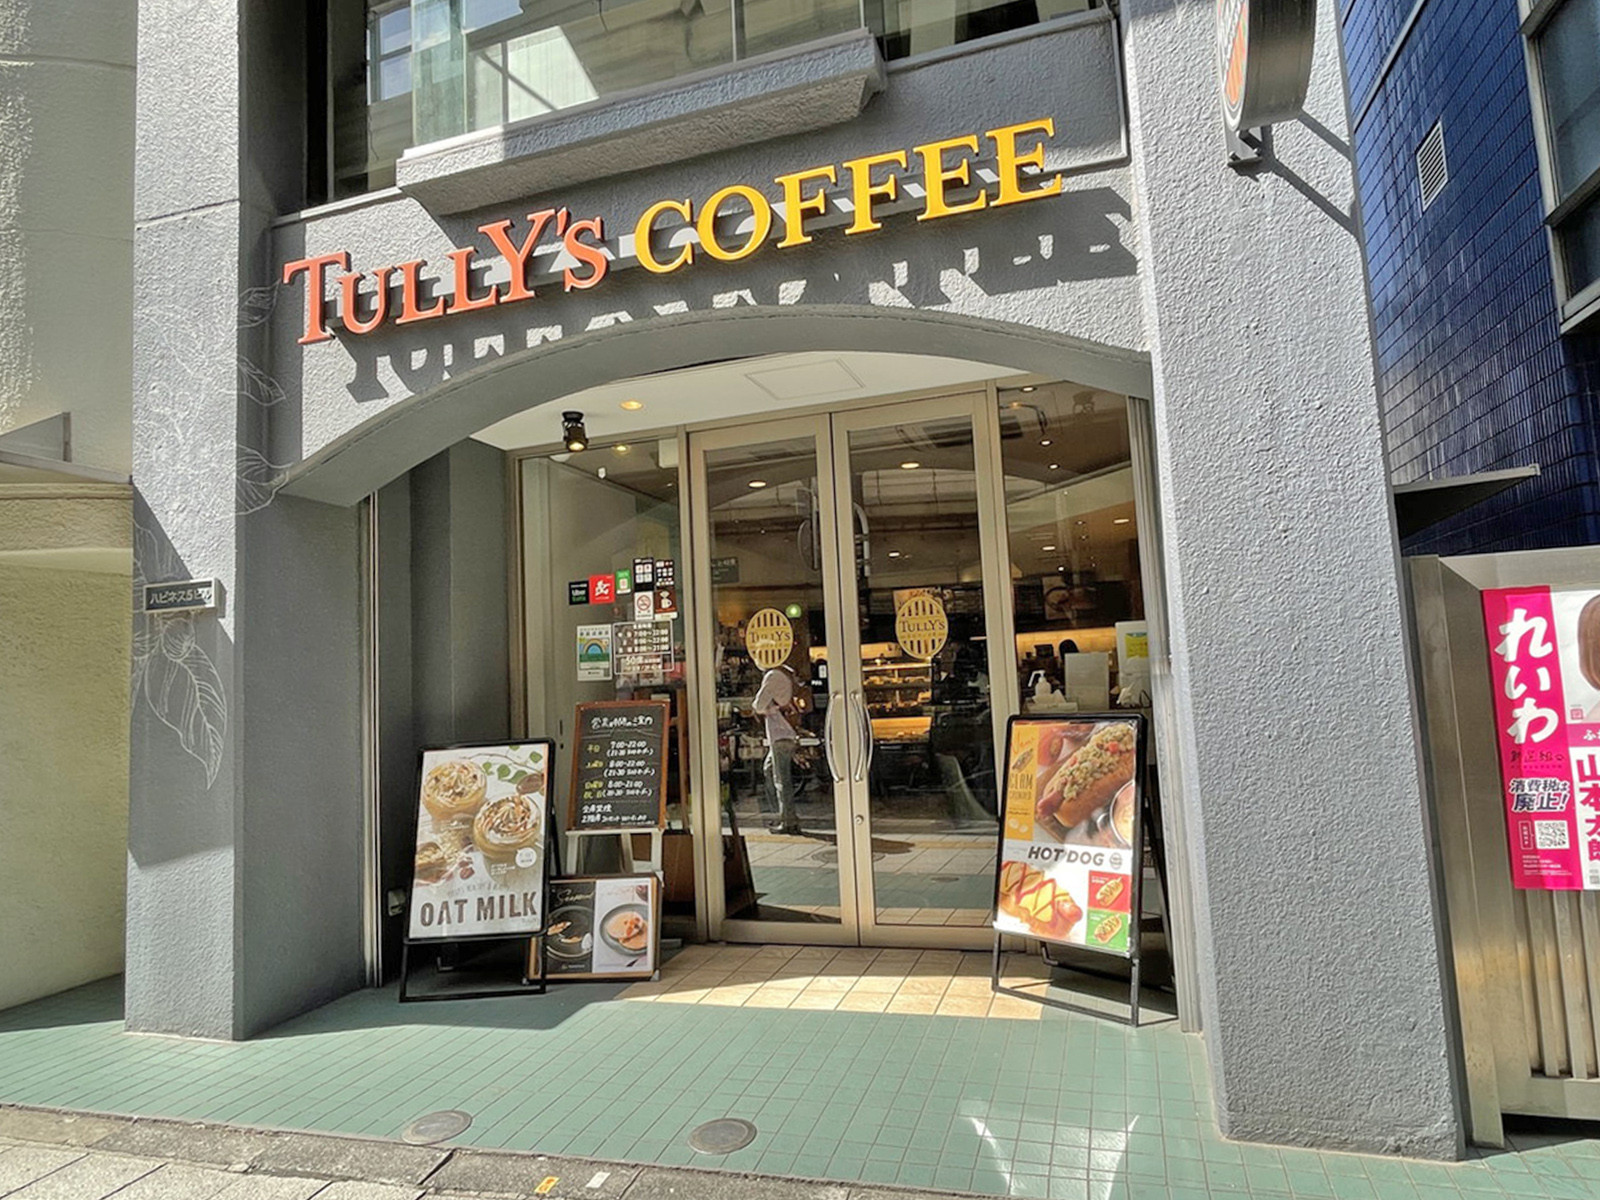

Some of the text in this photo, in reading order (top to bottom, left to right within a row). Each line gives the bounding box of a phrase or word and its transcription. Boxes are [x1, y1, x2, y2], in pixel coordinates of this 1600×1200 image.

[633, 117, 1062, 274] COFFEE
[1494, 608, 1559, 744] れいわ
[1509, 778, 1570, 793] 消費税は
[1027, 845, 1065, 862] HOT
[1066, 849, 1105, 867] DOG
[420, 898, 469, 927] OAT
[476, 891, 538, 922] MILK
